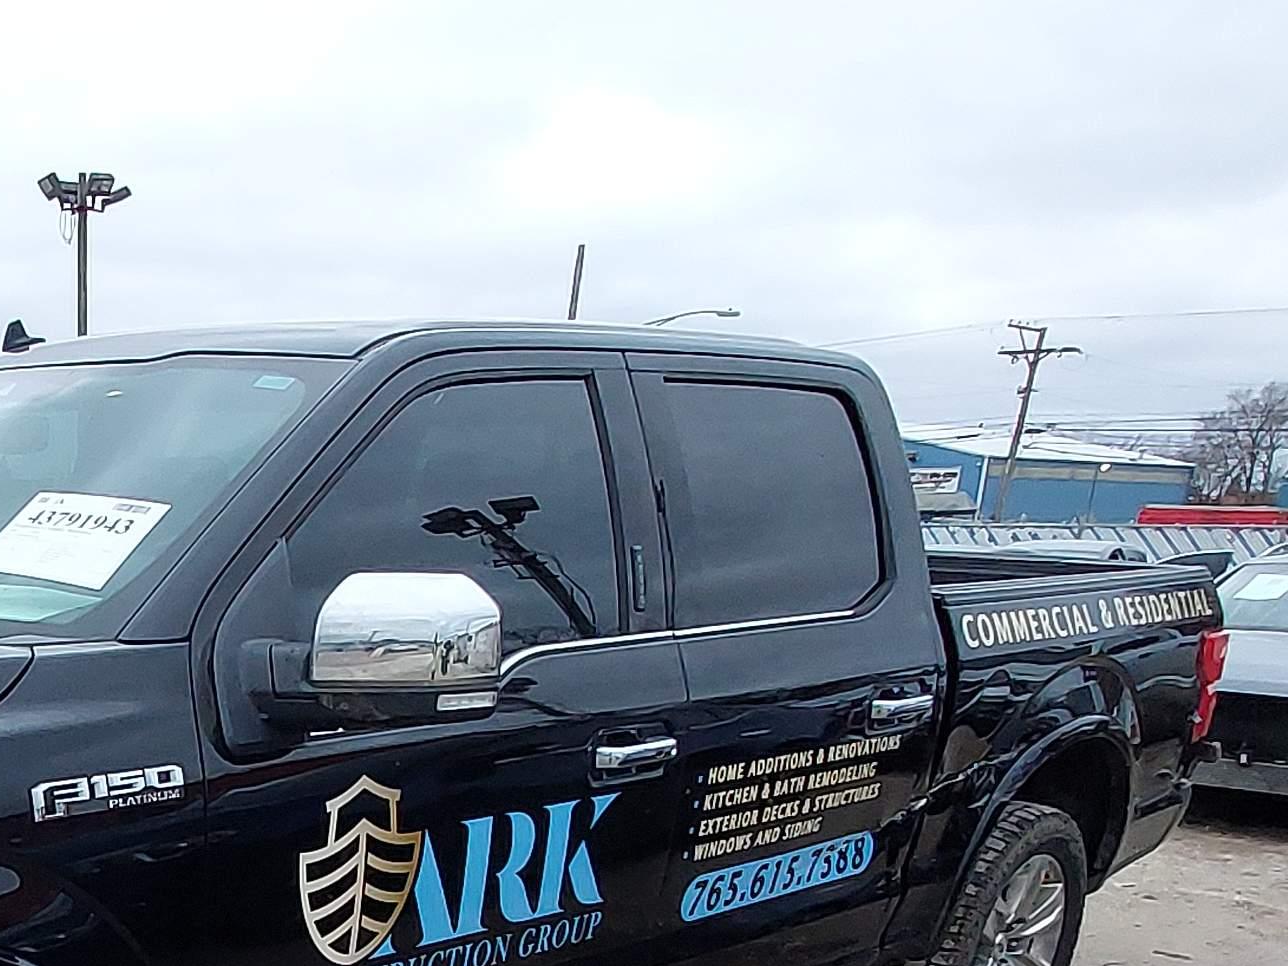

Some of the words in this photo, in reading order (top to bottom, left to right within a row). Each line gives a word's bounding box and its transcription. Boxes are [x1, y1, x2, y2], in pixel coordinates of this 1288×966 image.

[28, 510, 134, 534] 43791943
[962, 604, 1099, 648] COMMERCIAL
[1100, 599, 1113, 628] &
[1115, 588, 1213, 626] RESIDENTIAL
[708, 762, 745, 785] HOME
[747, 749, 813, 778] ADDITIONS
[816, 748, 824, 765] &
[827, 734, 902, 762] RENOVATIONS
[109, 788, 180, 809] PLATINUM
[698, 809, 759, 837] EXTERIOR
[762, 798, 799, 823] DECKS
[812, 782, 881, 812] STRUCTURES
[703, 787, 759, 811] KITCHEN
[761, 782, 770, 800] &
[774, 775, 805, 796] BATH
[807, 761, 878, 790] REMODELING
[693, 834, 751, 861] WINDOWS
[753, 826, 780, 847] AND
[782, 816, 823, 841] SIDING
[368, 792, 622, 960] ARK
[518, 911, 603, 958] GROUP
